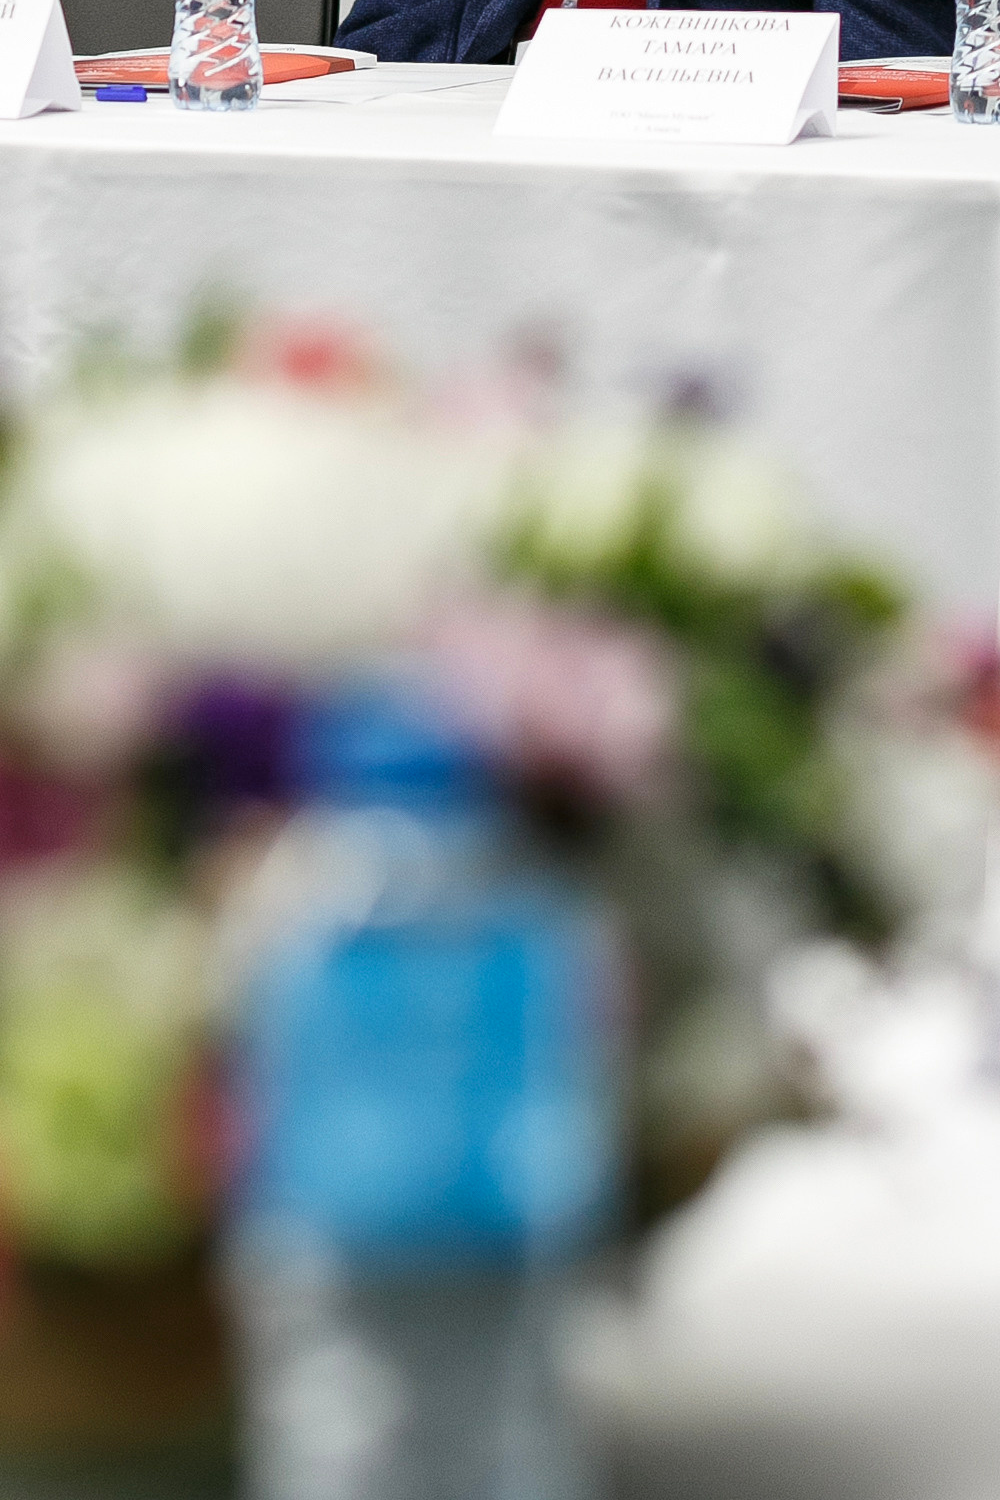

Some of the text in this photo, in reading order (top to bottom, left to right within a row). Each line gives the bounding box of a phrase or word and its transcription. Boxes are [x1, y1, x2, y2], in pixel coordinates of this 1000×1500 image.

[608, 14, 791, 32] КОЖЕВНИКОВА
[642, 39, 737, 56] ТАМАРА
[596, 66, 755, 85] ВАСИЛЬЕВНА
